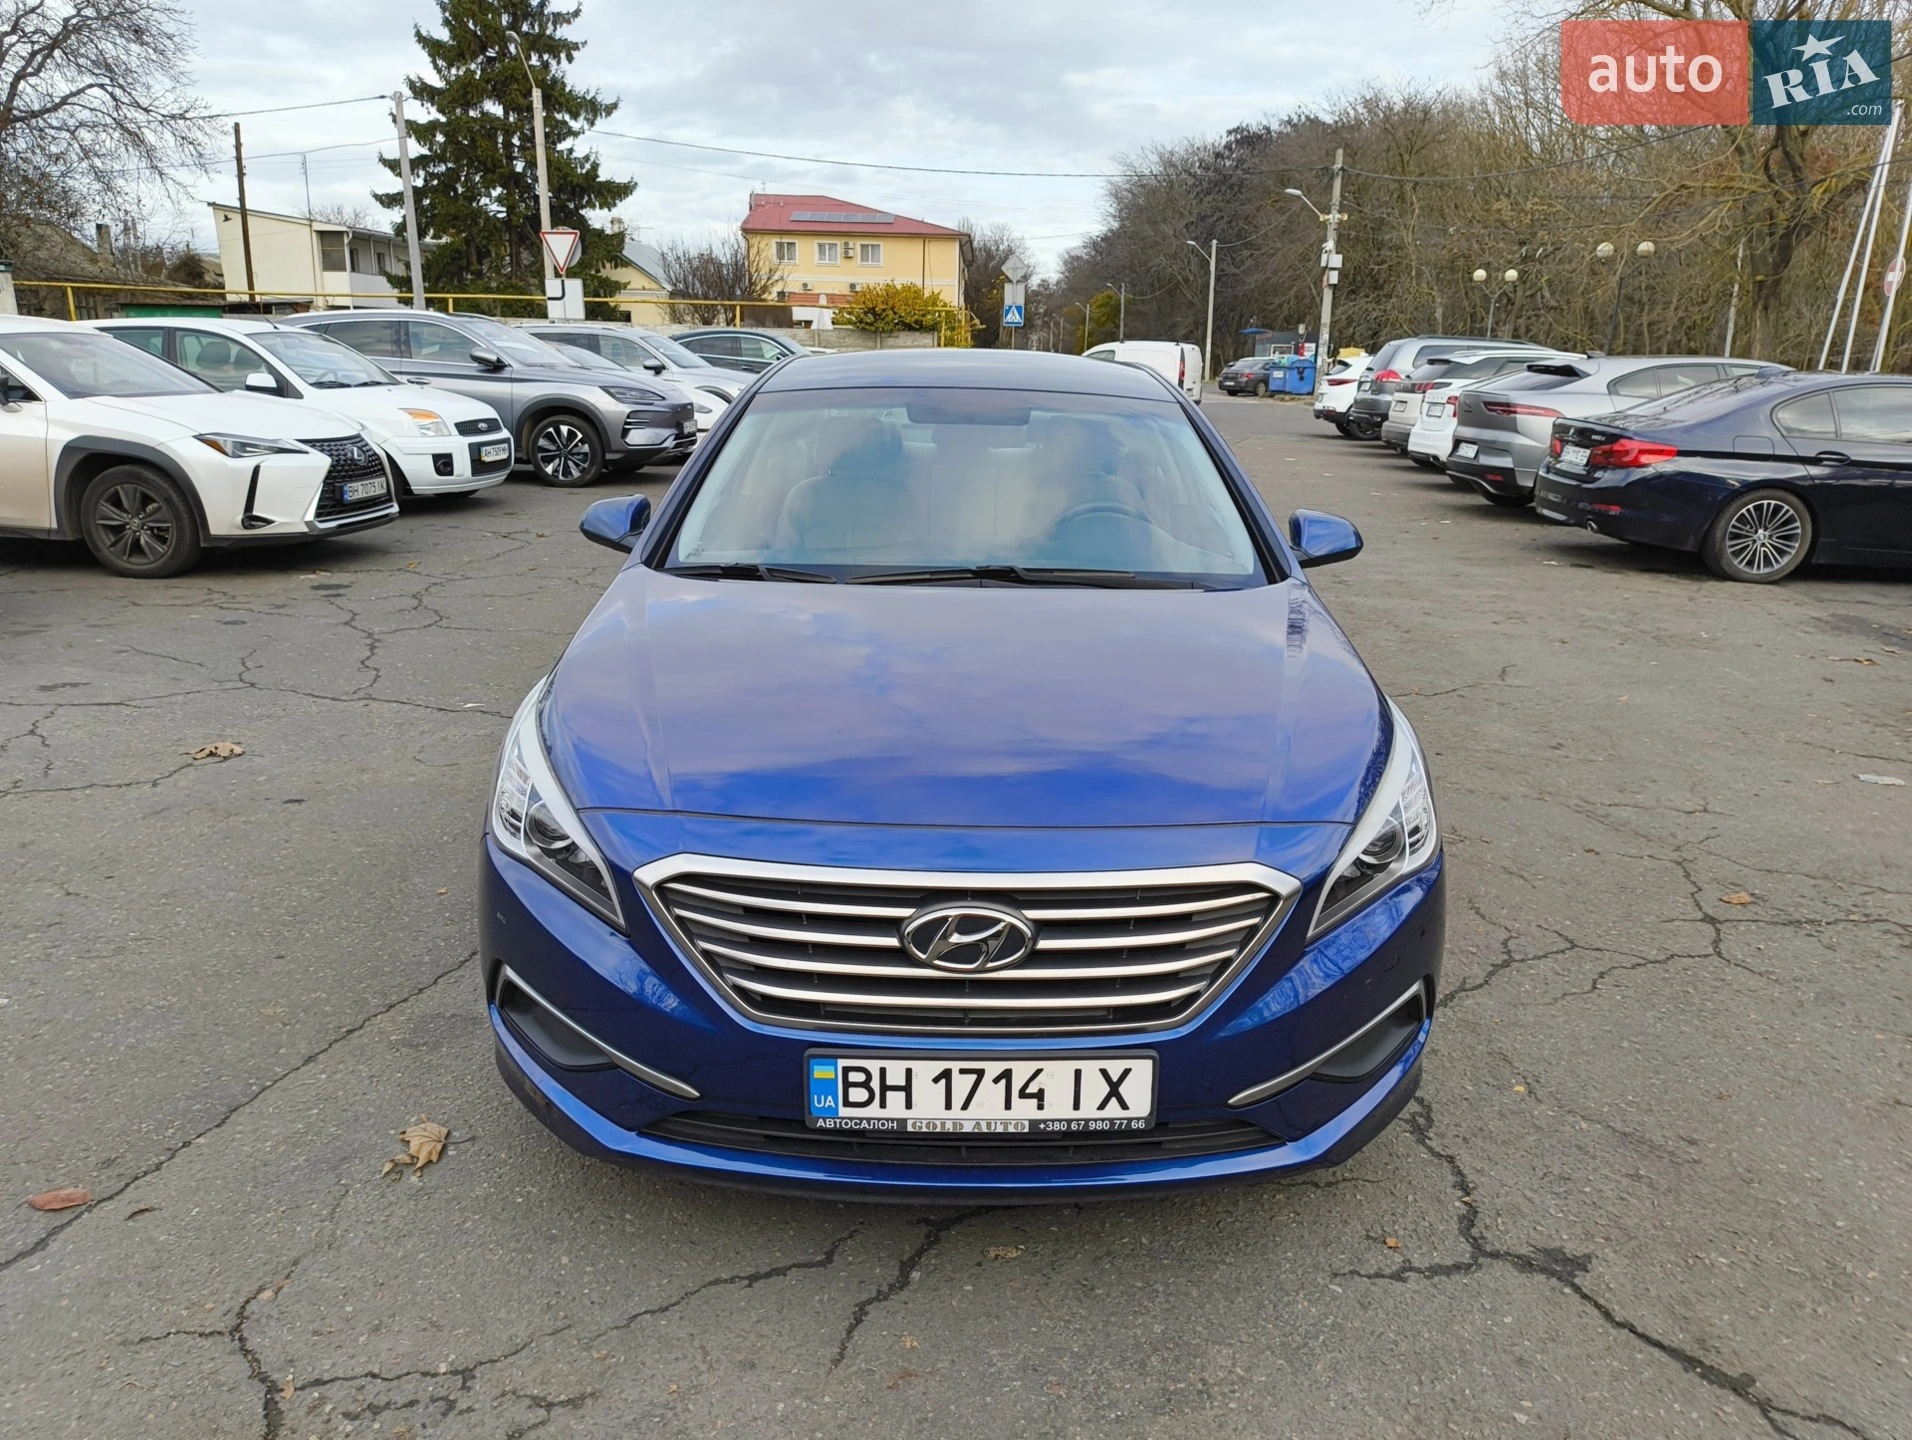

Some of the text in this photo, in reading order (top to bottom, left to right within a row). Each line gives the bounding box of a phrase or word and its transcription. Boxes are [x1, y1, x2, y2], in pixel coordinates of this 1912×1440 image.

[348, 485, 359, 498] BH
[360, 482, 377, 496] 7075
[841, 1065, 1133, 1111] BH 1714 IX
[814, 1095, 835, 1108] UA
[816, 1118, 897, 1130] АВТОСАЛОН
[911, 1120, 1027, 1132] GOLD AUTO
[1038, 1119, 1146, 1131] +380 67 980 77 66
